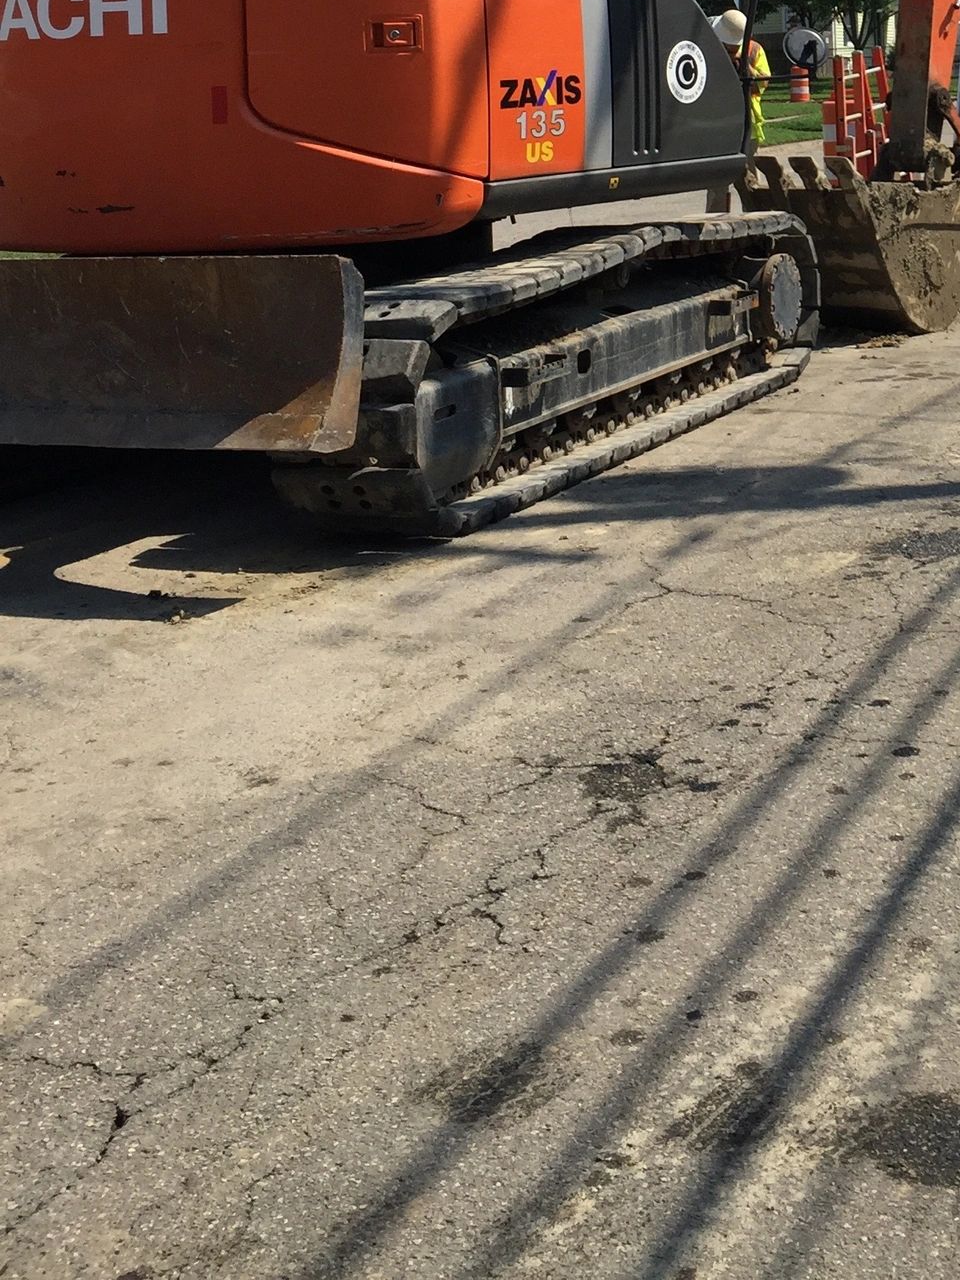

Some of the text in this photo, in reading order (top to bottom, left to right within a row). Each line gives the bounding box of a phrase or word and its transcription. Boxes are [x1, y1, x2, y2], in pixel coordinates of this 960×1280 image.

[499, 70, 581, 109] ZAXIS
[516, 110, 566, 139] 135
[526, 141, 554, 163] US
